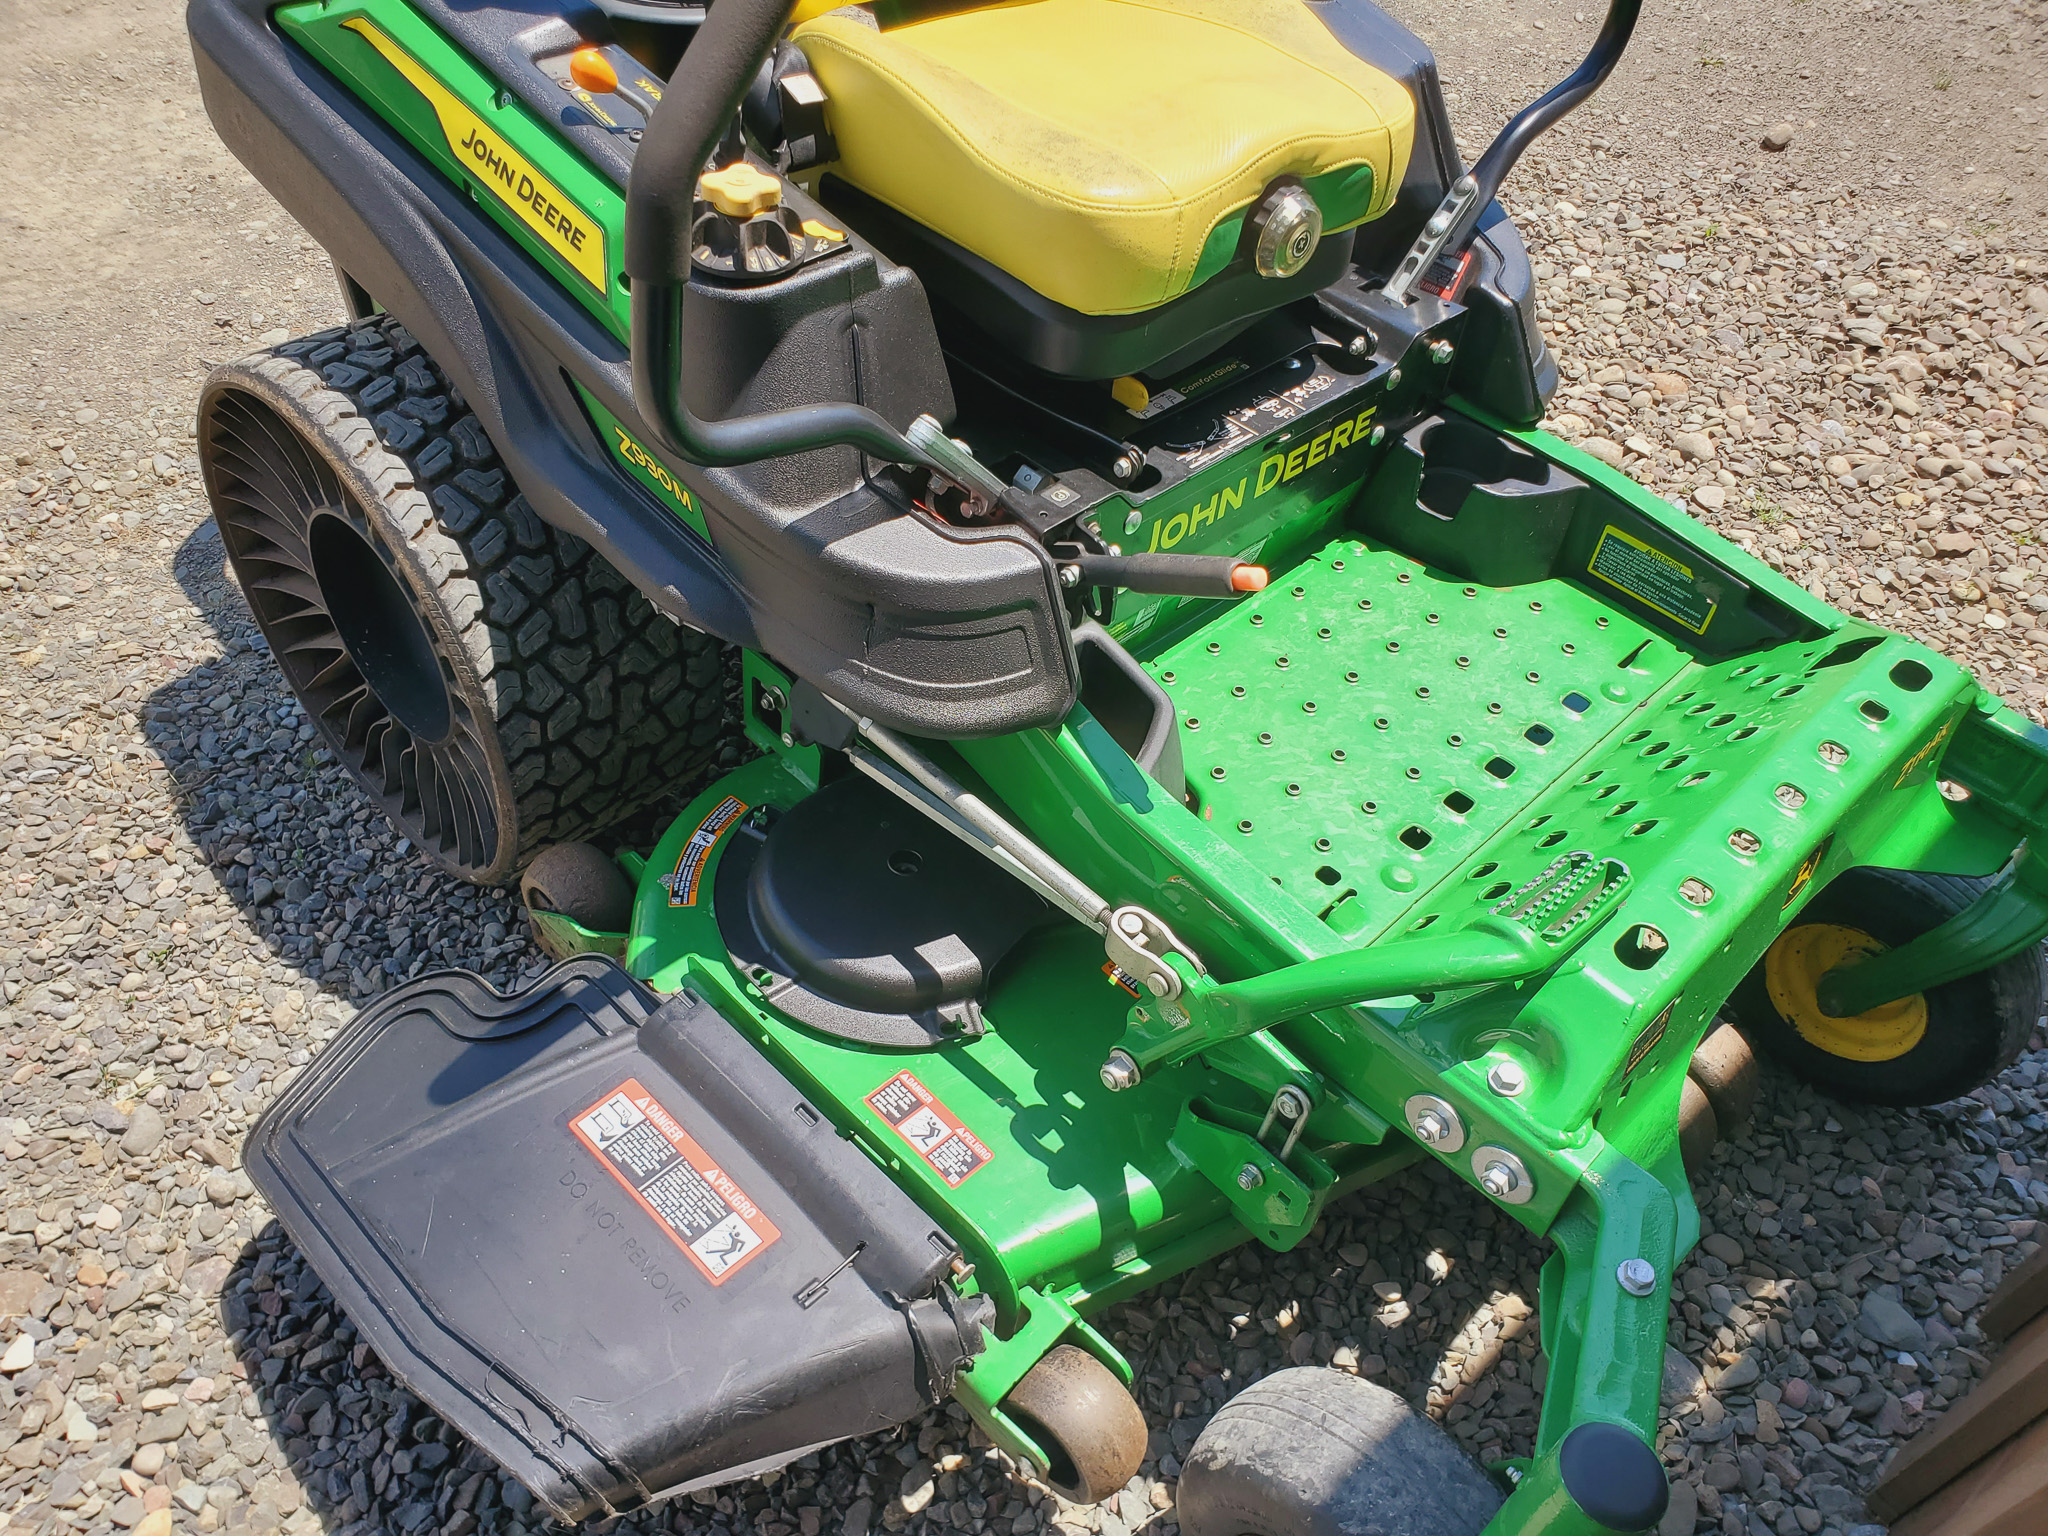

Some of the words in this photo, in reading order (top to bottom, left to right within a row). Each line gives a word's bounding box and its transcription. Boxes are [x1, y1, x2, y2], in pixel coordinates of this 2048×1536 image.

[461, 127, 516, 189] JOHN
[516, 173, 587, 253] DEERE
[614, 425, 694, 513] Z930M
[1147, 476, 1248, 554] JOHN
[1253, 405, 1378, 499] DEERE
[1651, 550, 1683, 572] ATENCION
[907, 1077, 934, 1104] DANGER
[644, 1103, 685, 1143] DANGER
[962, 1132, 993, 1161] PELIGRO
[714, 1176, 757, 1220] PELIGRO
[558, 1169, 588, 1199] DO
[585, 1199, 625, 1237] NOT
[622, 1236, 692, 1314] REMOVE
